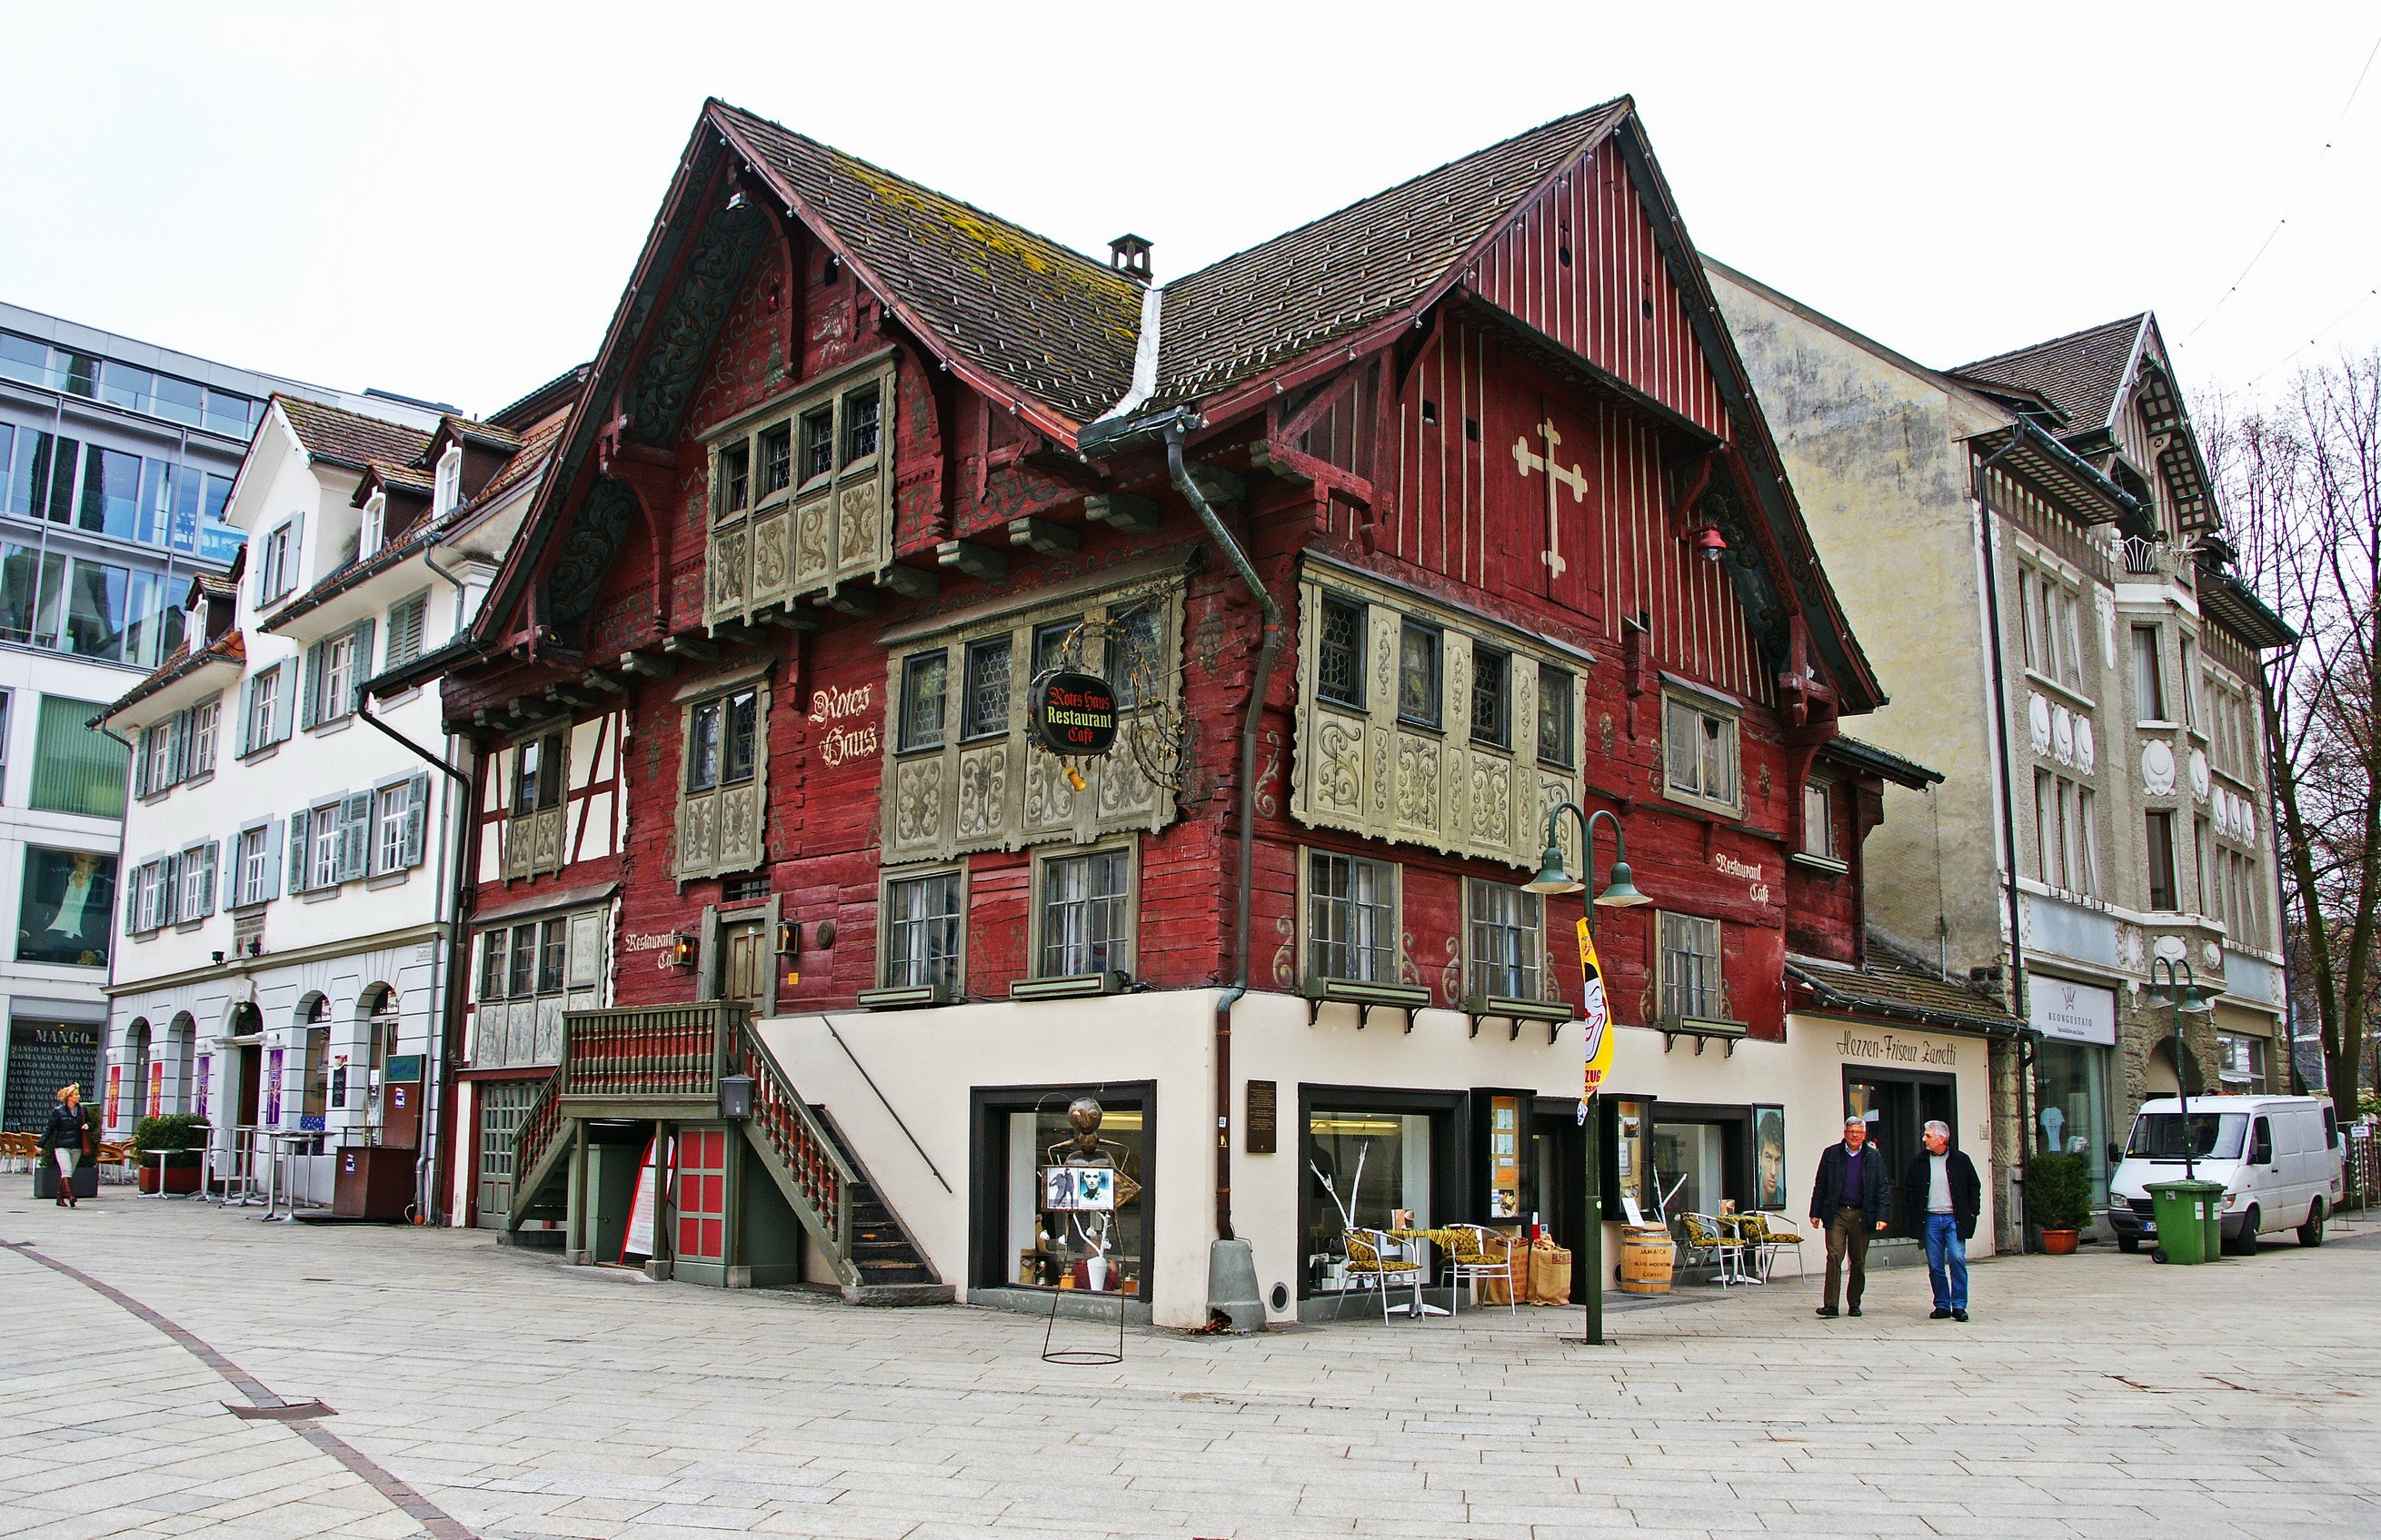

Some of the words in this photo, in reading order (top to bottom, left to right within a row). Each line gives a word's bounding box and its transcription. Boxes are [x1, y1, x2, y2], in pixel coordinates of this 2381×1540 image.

[808, 682, 872, 729] Rotes
[1048, 686, 1083, 708] Rotes
[1084, 691, 1111, 710] Haus
[1047, 706, 1112, 728] Restaurant
[819, 721, 877, 769] Haus
[1715, 852, 1762, 881] Restaurant
[2047, 1011, 2093, 1027] BUONGUSTAIO
[35, 1029, 90, 1045] MANGO
[1921, 1040, 1957, 1066] Zanetti
